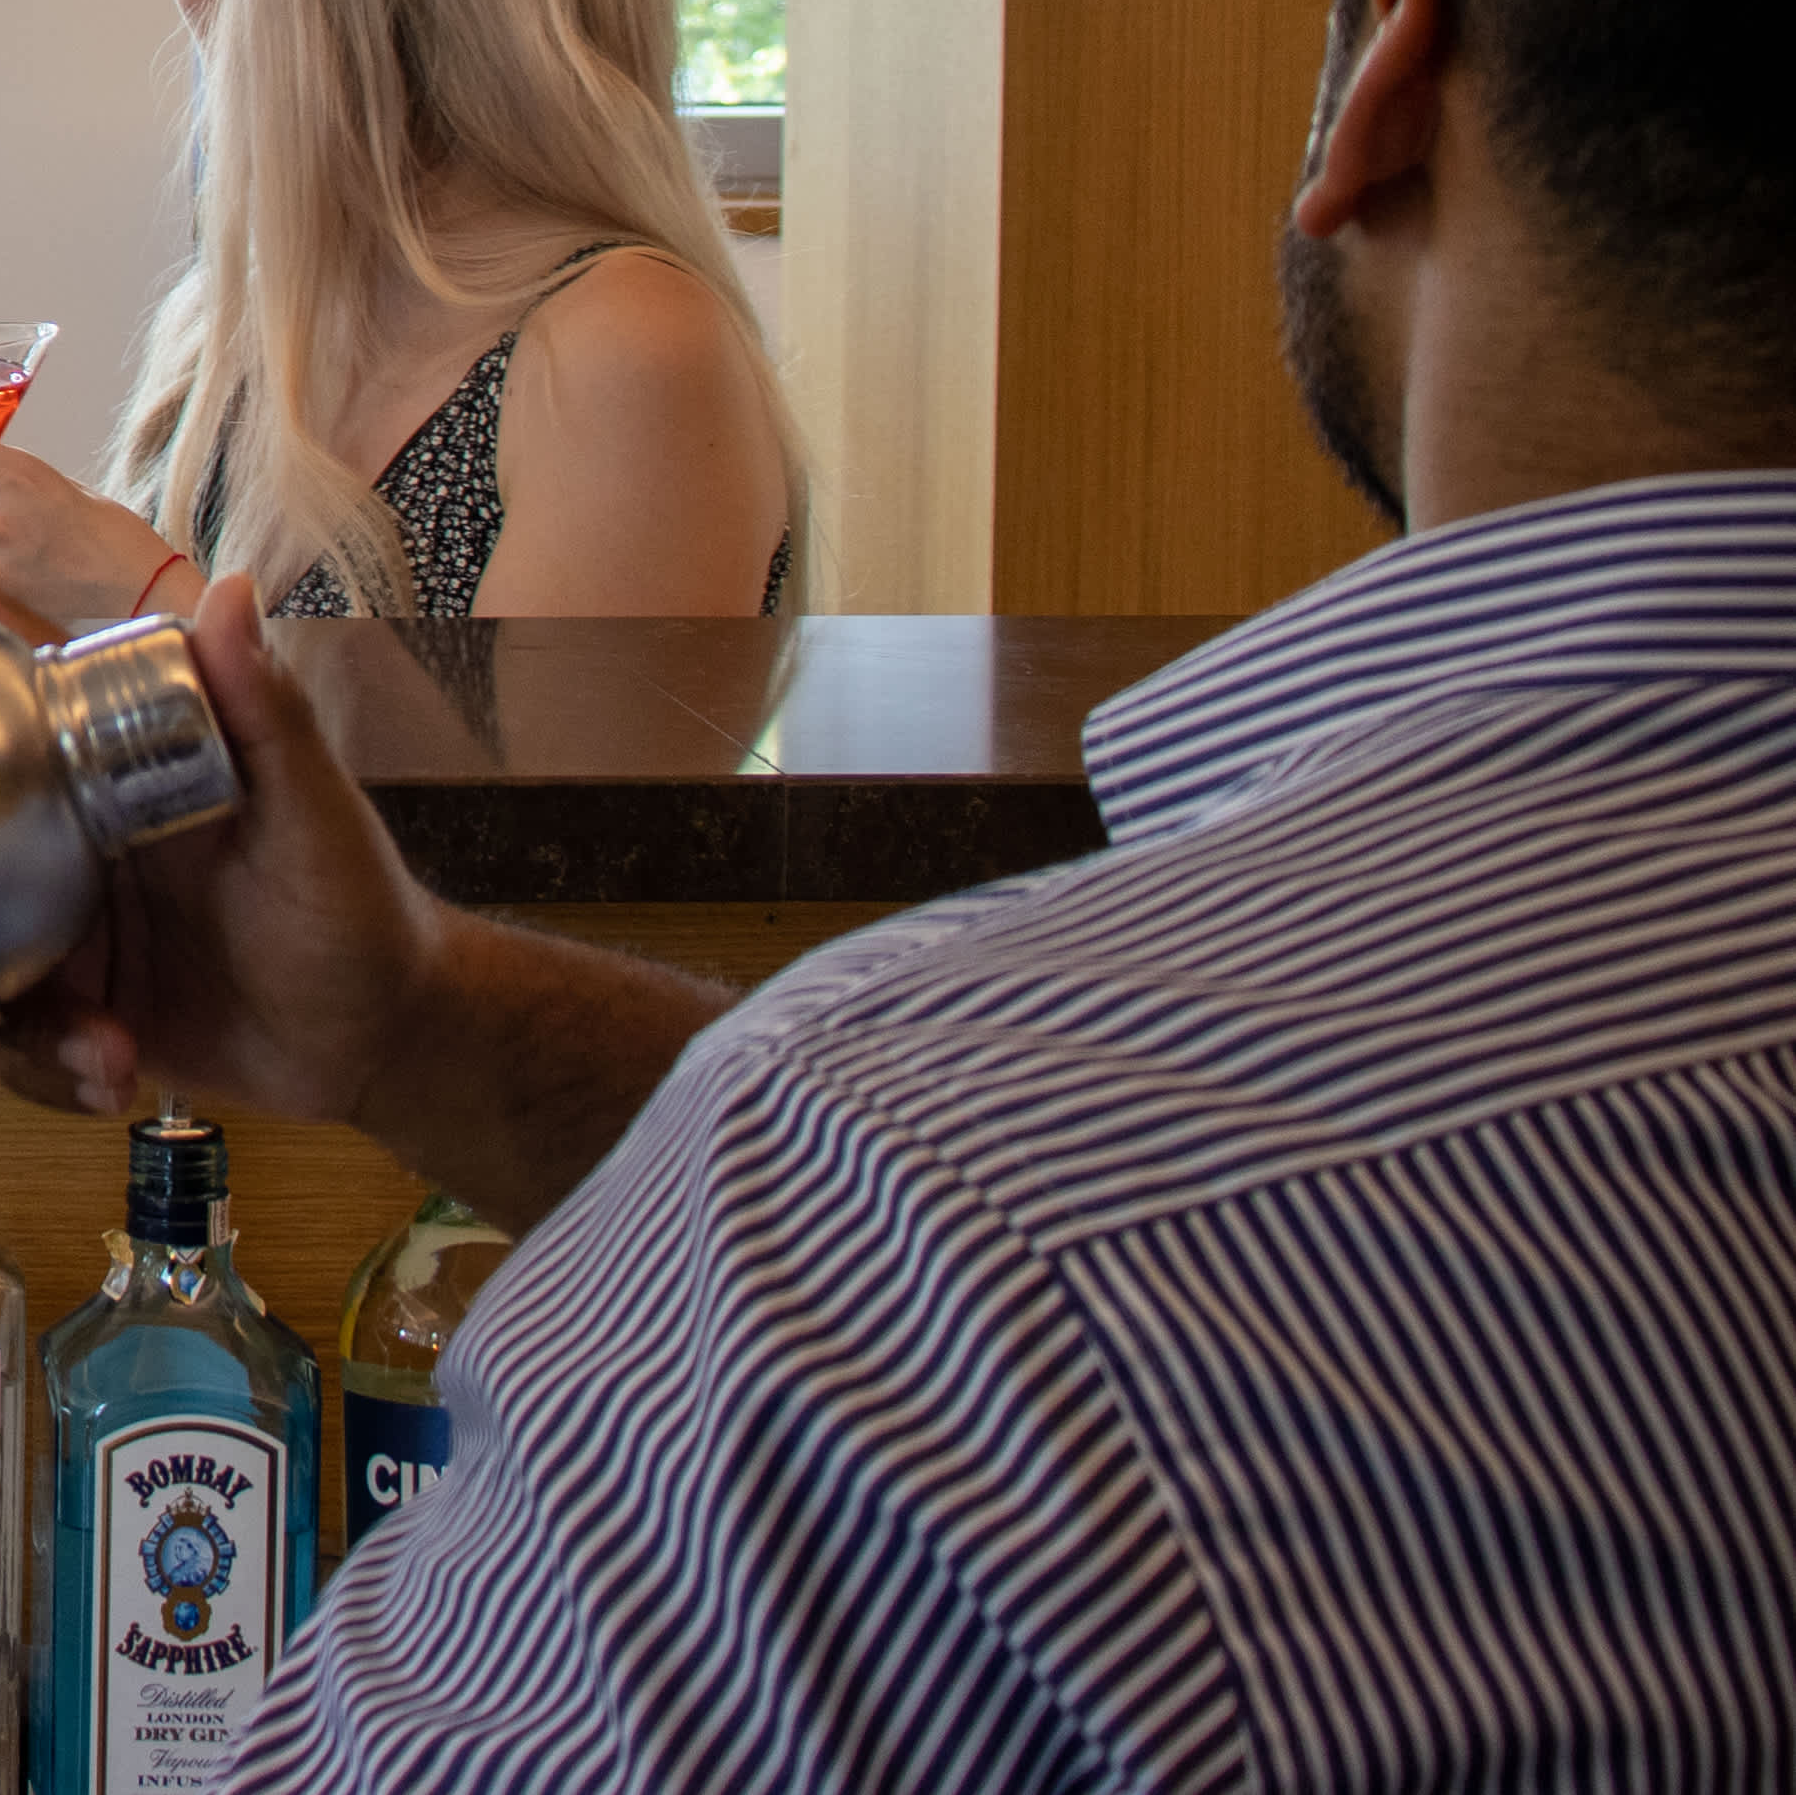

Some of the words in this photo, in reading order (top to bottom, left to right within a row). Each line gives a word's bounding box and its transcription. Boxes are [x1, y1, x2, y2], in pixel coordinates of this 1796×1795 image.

[124, 1454, 254, 1510] BOMBAY
[114, 1621, 253, 1675] SAPPHIRE
[137, 1683, 236, 1708] Distilled
[147, 1712, 225, 1725] LONDON
[135, 1726, 186, 1742] DRY
[149, 1748, 214, 1773] Vapou
[137, 1775, 203, 1788] INFUS
